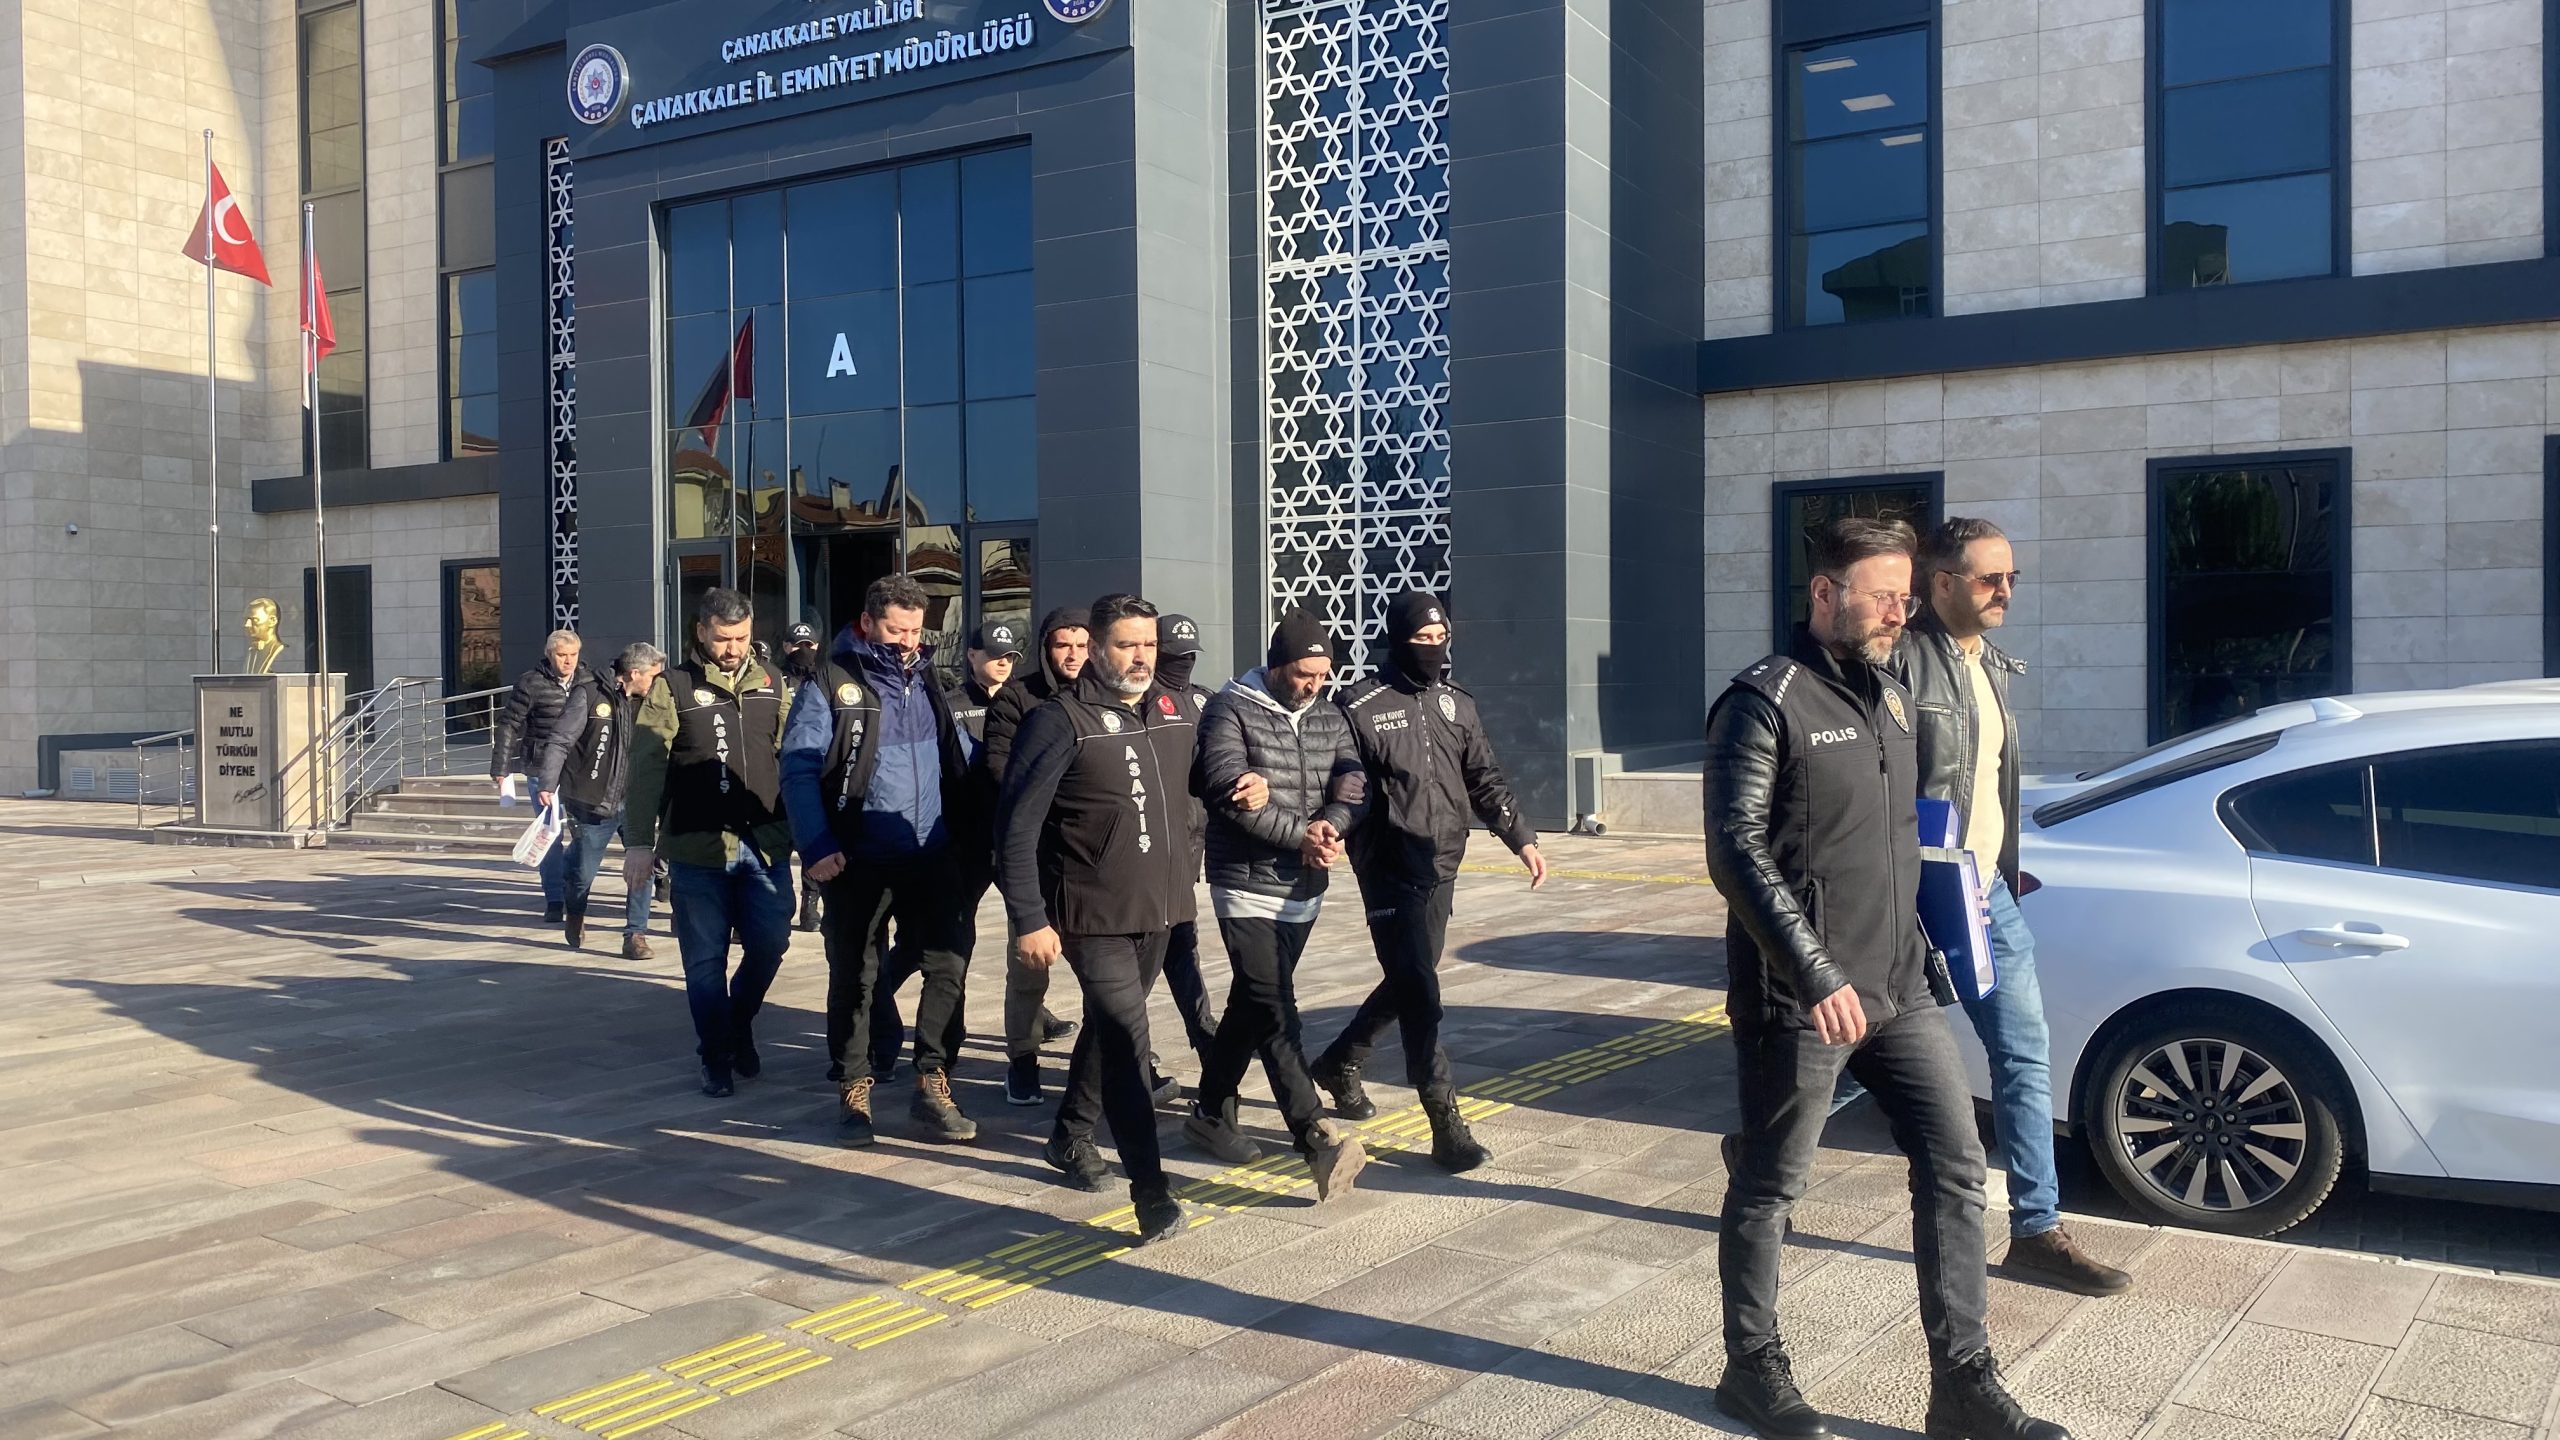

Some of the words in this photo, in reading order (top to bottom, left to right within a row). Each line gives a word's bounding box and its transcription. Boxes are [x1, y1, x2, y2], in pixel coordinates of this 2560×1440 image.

[721, 17, 836, 64] ÇANAKKALE
[631, 79, 752, 129] ÇANAKKALE
[757, 71, 777, 100] İL
[781, 52, 881, 96] EMNİYET
[884, 13, 1034, 75] MÜDÜRLÜĞÜ
[827, 332, 857, 378] A
[229, 706, 244, 718] NE
[219, 726, 254, 737] MUTLU
[216, 743, 258, 757] TÜRKÜM
[219, 762, 256, 776] DİYENE
